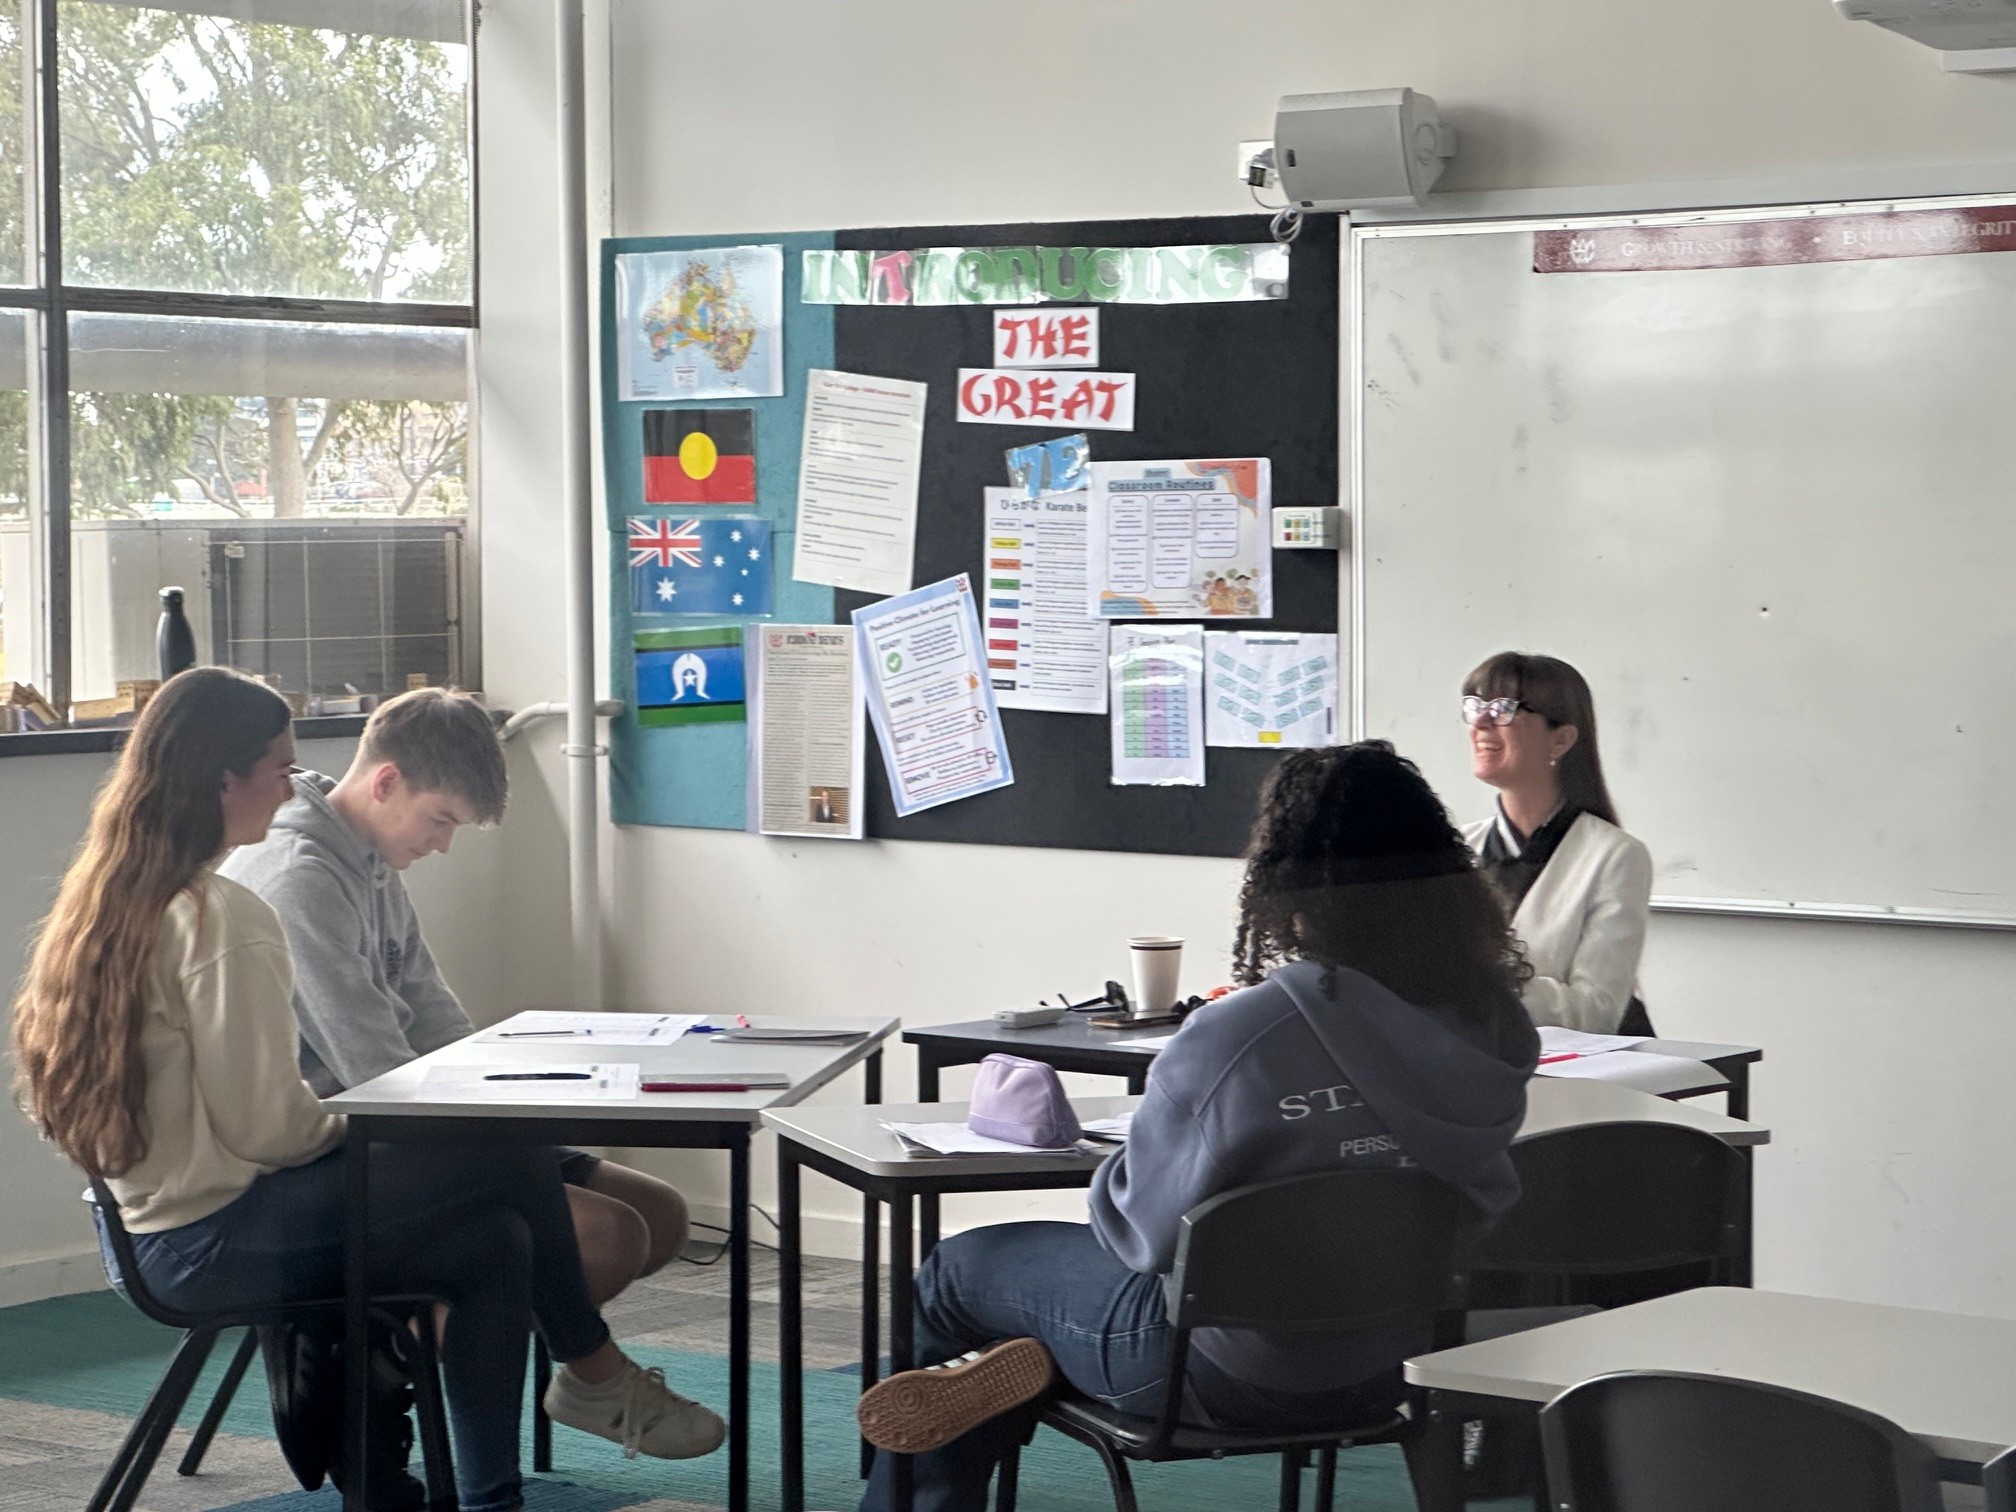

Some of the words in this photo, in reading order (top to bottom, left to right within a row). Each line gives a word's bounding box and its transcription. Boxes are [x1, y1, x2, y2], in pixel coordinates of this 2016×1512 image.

[804, 245, 1249, 303] INTRODUCING
[998, 314, 1091, 361] THE
[961, 372, 1129, 422] GREAT
[1108, 480, 1163, 490] Classroom
[1165, 479, 1215, 490] Routines
[1045, 502, 1074, 512] Karate
[1278, 1084, 1366, 1121] ST
